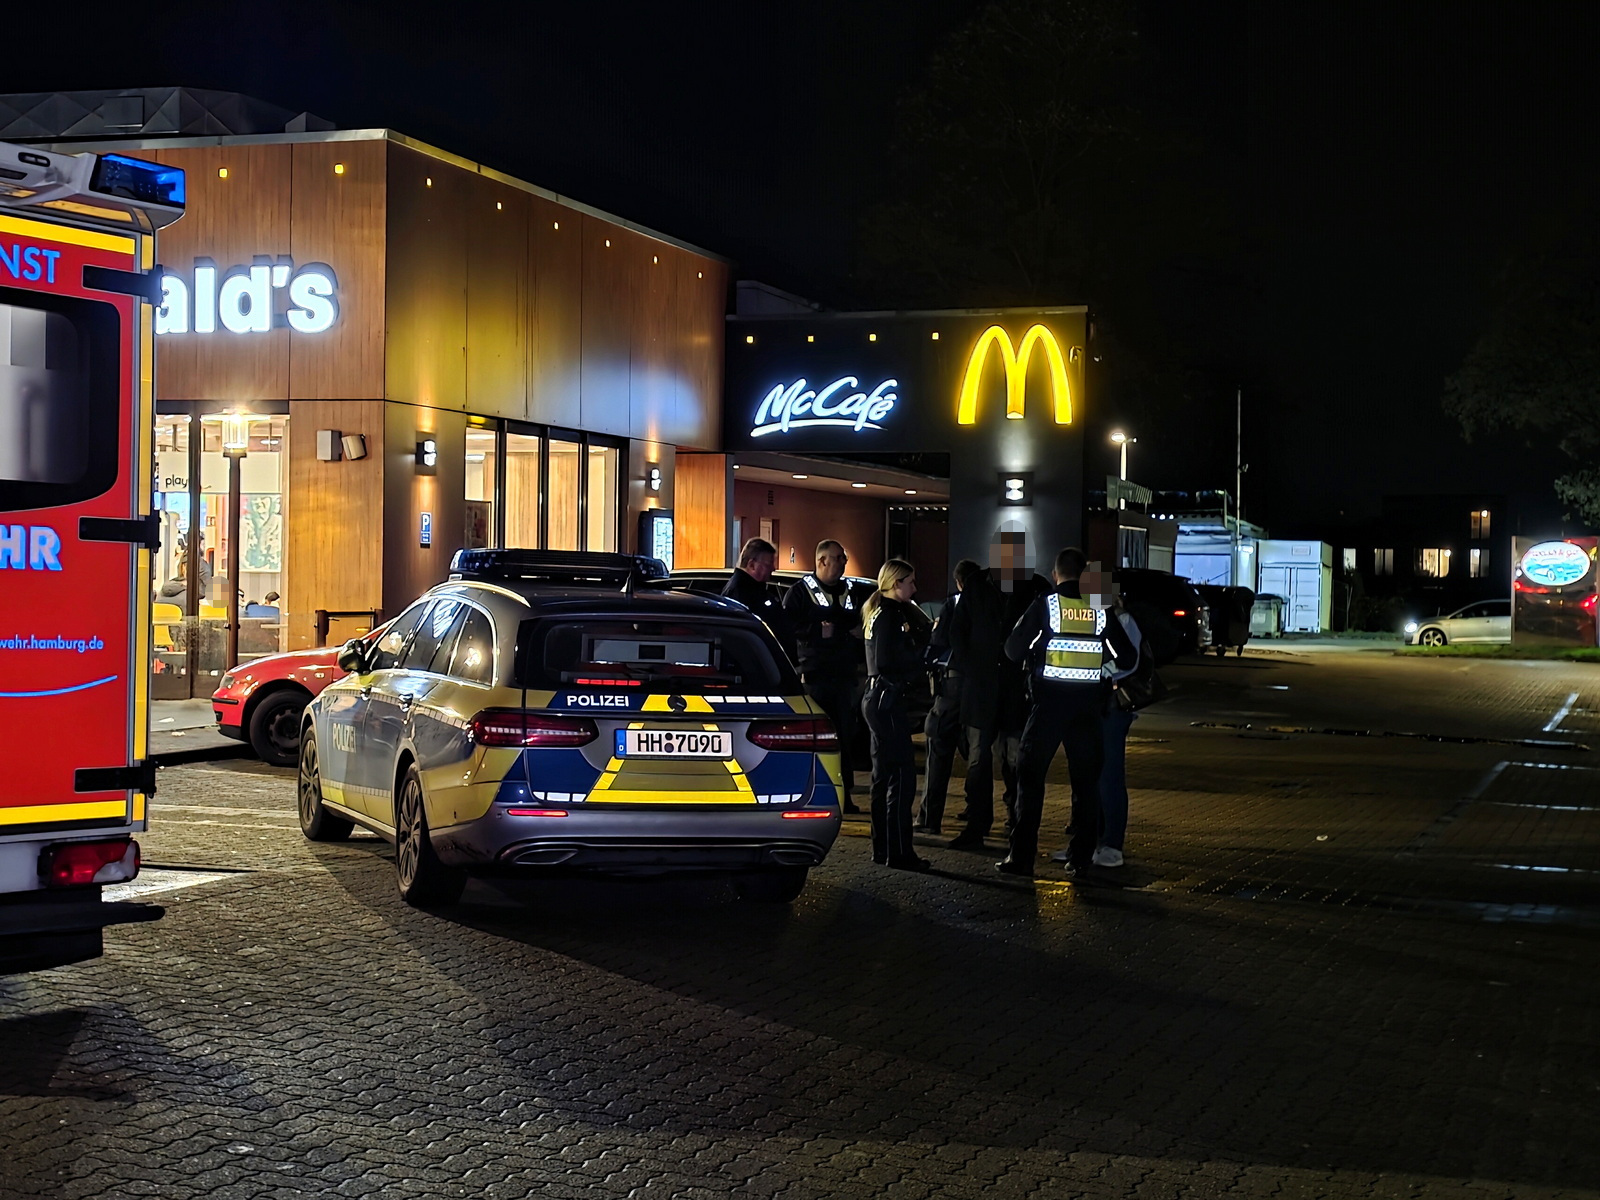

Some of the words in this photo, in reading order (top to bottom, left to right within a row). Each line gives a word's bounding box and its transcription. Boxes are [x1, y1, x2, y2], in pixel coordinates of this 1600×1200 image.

[753, 375, 899, 434] McCafé
[165, 474, 188, 489] play
[422, 514, 430, 531] P
[1062, 608, 1096, 622] POLIZEI
[566, 695, 630, 707] POLIZEI
[332, 722, 357, 753] POLIZEI
[675, 734, 722, 753] 7090
